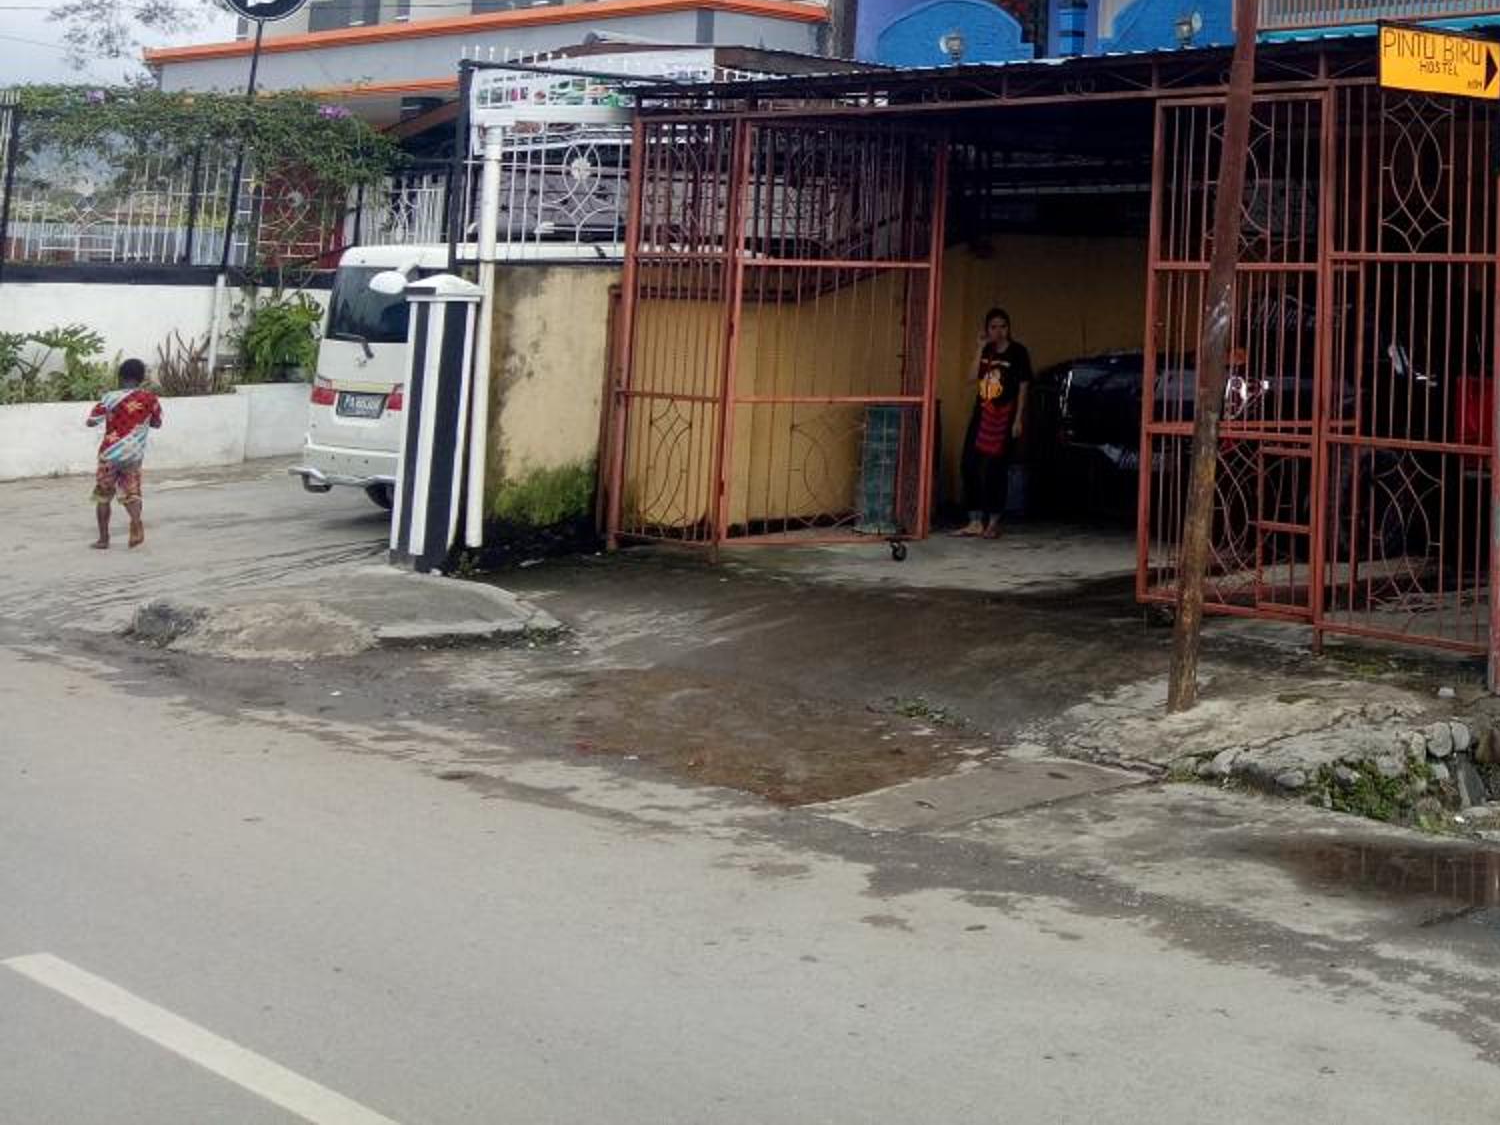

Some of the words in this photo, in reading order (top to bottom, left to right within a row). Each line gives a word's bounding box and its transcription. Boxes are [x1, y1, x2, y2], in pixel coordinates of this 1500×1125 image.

[1383, 31, 1435, 60] PINTU
[1443, 36, 1481, 65] BIRU
[1420, 60, 1458, 77] HOSTEL
